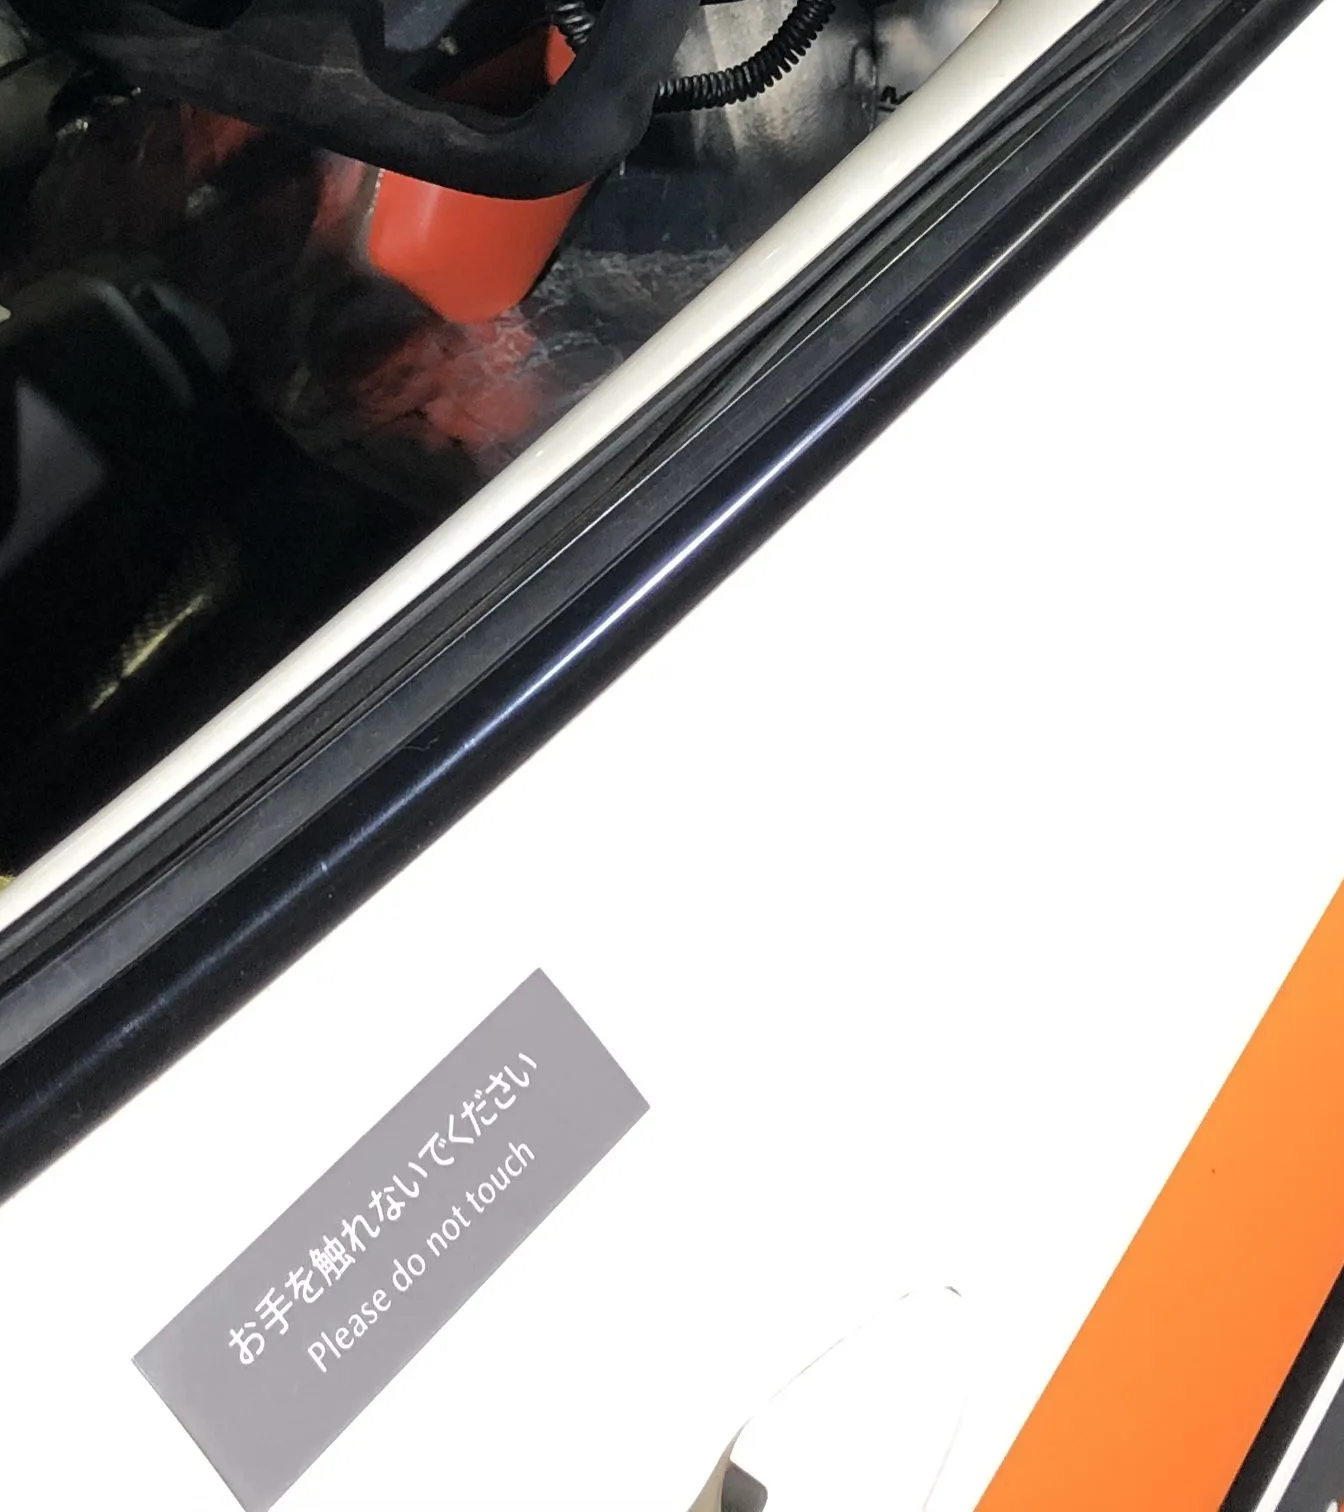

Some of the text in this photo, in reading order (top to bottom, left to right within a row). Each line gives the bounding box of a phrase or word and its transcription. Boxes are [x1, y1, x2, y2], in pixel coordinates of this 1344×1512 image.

[226, 1052, 538, 1366] お手を触れないでください
[307, 1140, 536, 1374] Please do not touch
